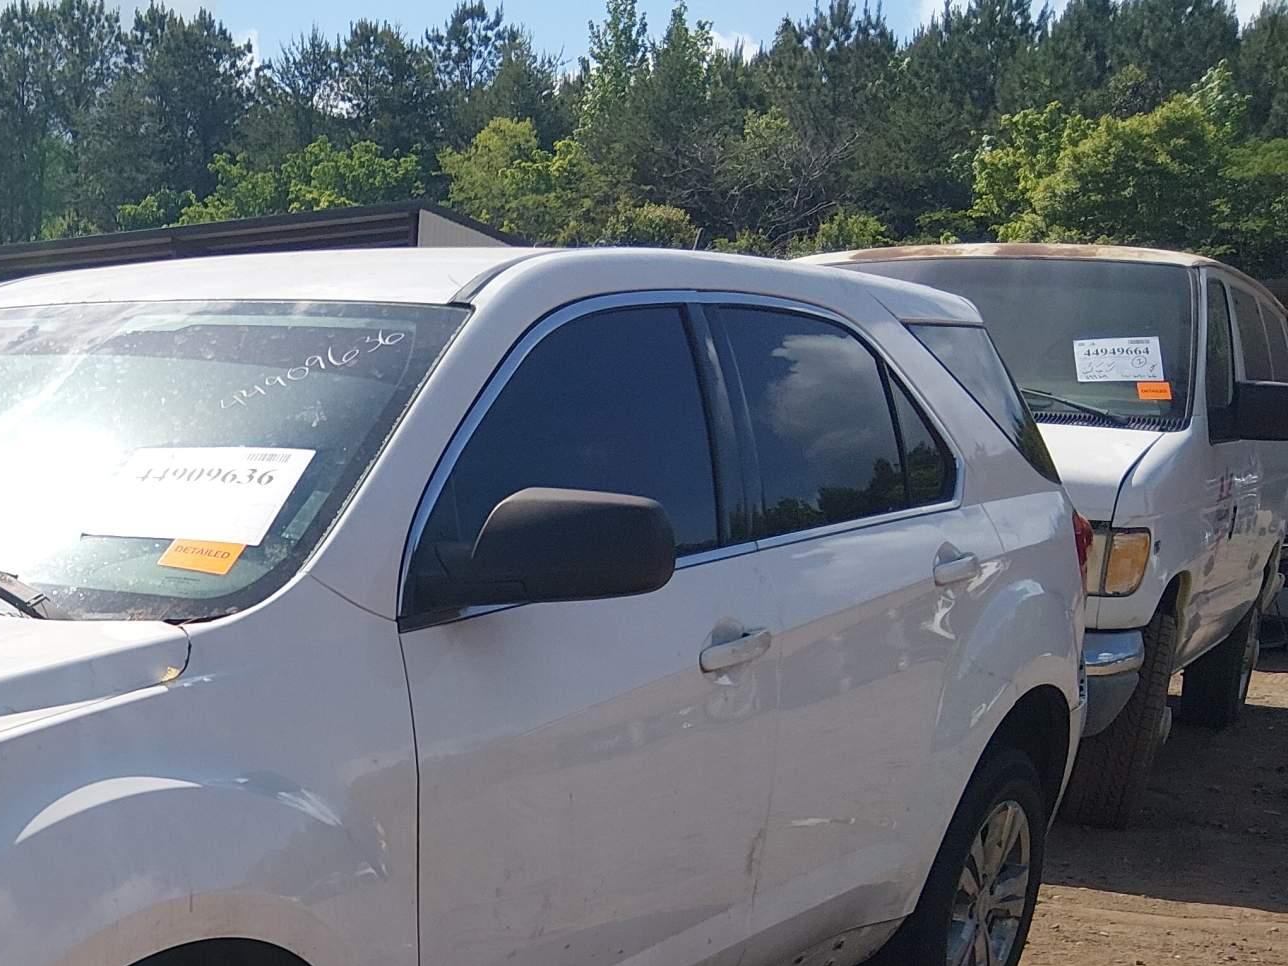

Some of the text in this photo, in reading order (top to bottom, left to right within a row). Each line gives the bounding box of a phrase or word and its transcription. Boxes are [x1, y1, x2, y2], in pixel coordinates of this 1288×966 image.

[1083, 347, 1150, 357] 44949664
[136, 467, 278, 486] 44909636
[174, 545, 231, 560] DETAILED
